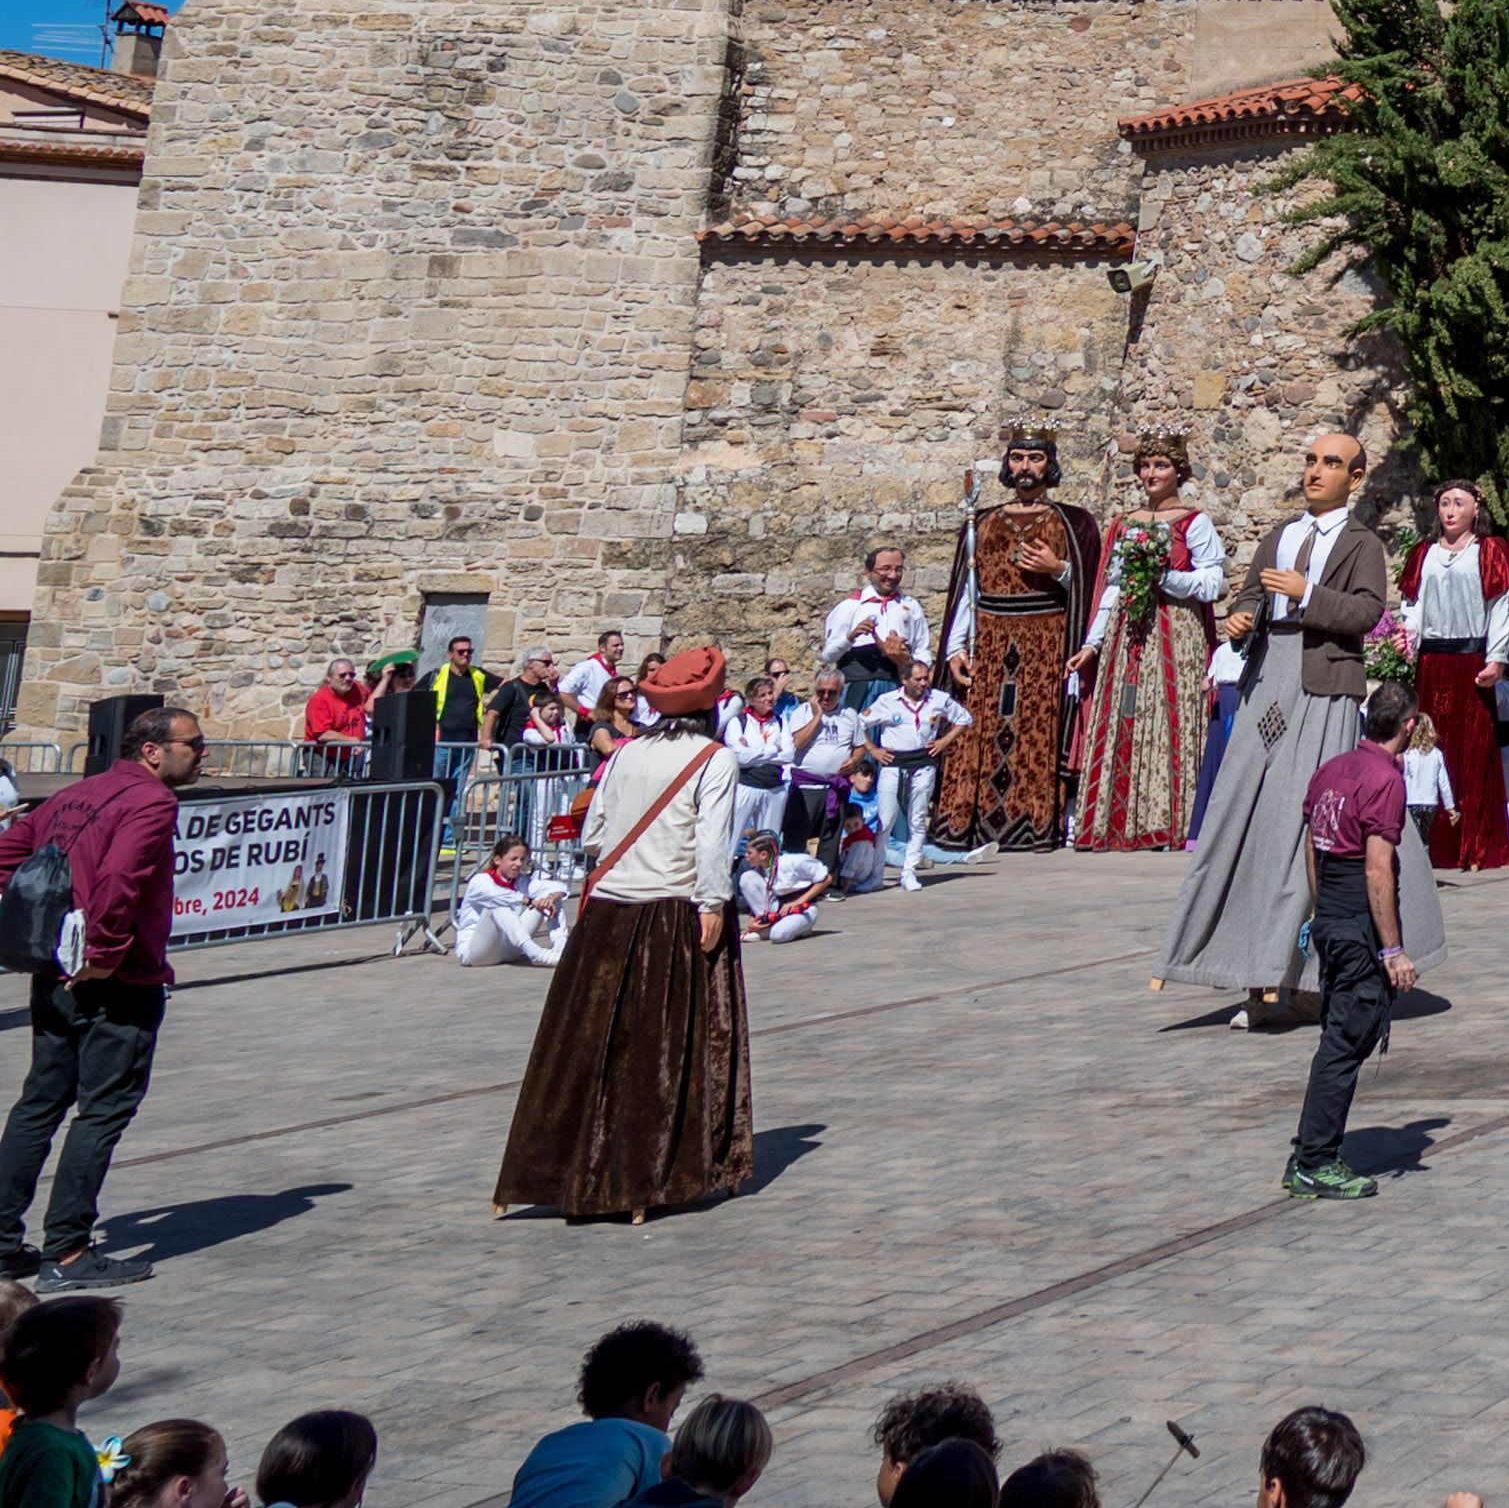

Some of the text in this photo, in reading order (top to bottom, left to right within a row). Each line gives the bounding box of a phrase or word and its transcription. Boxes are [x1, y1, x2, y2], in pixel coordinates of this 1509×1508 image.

[186, 813, 222, 839] DE
[225, 802, 335, 835] GEGANTS
[210, 844, 242, 871] DE
[246, 831, 311, 867] RUBÍ
[212, 886, 260, 910] 2024
